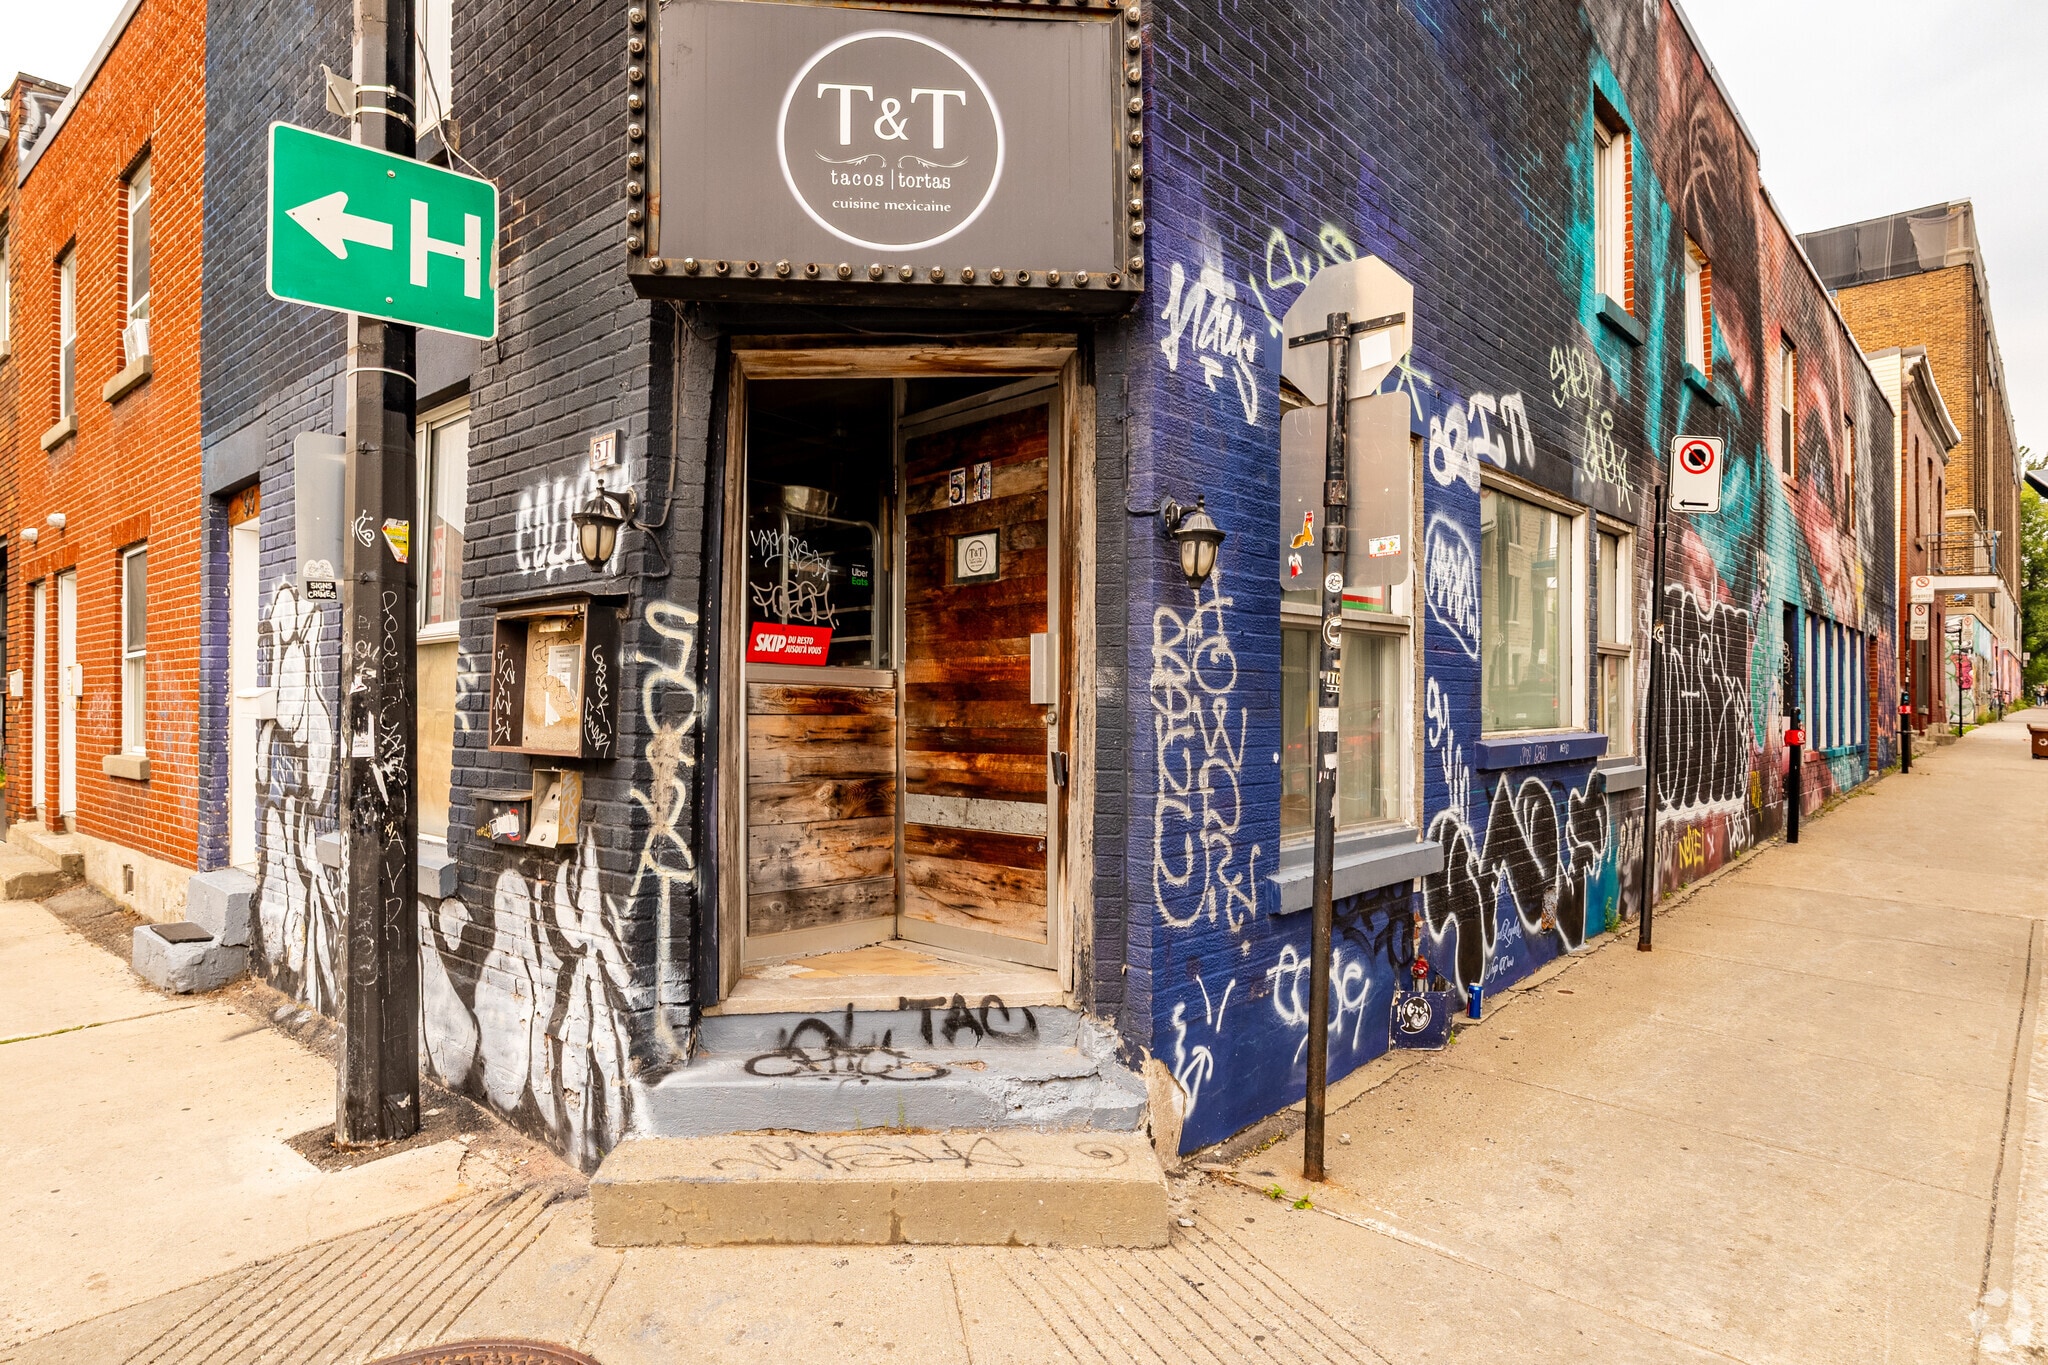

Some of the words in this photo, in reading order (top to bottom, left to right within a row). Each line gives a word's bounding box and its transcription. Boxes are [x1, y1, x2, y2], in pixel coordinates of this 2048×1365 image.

[817, 83, 967, 149] T&T
[830, 169, 884, 187] tacos
[897, 170, 951, 190] tortas
[832, 198, 880, 210] cuisine
[884, 199, 952, 212] mexicaine
[410, 201, 482, 299] H
[593, 441, 610, 461] 51
[949, 464, 986, 504] 51
[969, 547, 984, 558] T&T
[852, 567, 869, 578] Uber
[310, 582, 333, 590] SIGNS
[852, 576, 869, 586] Eats
[754, 633, 787, 653] SKIP
[787, 635, 797, 644] DU
[796, 636, 814, 645] RESTO
[807, 646, 822, 655] VOUS
